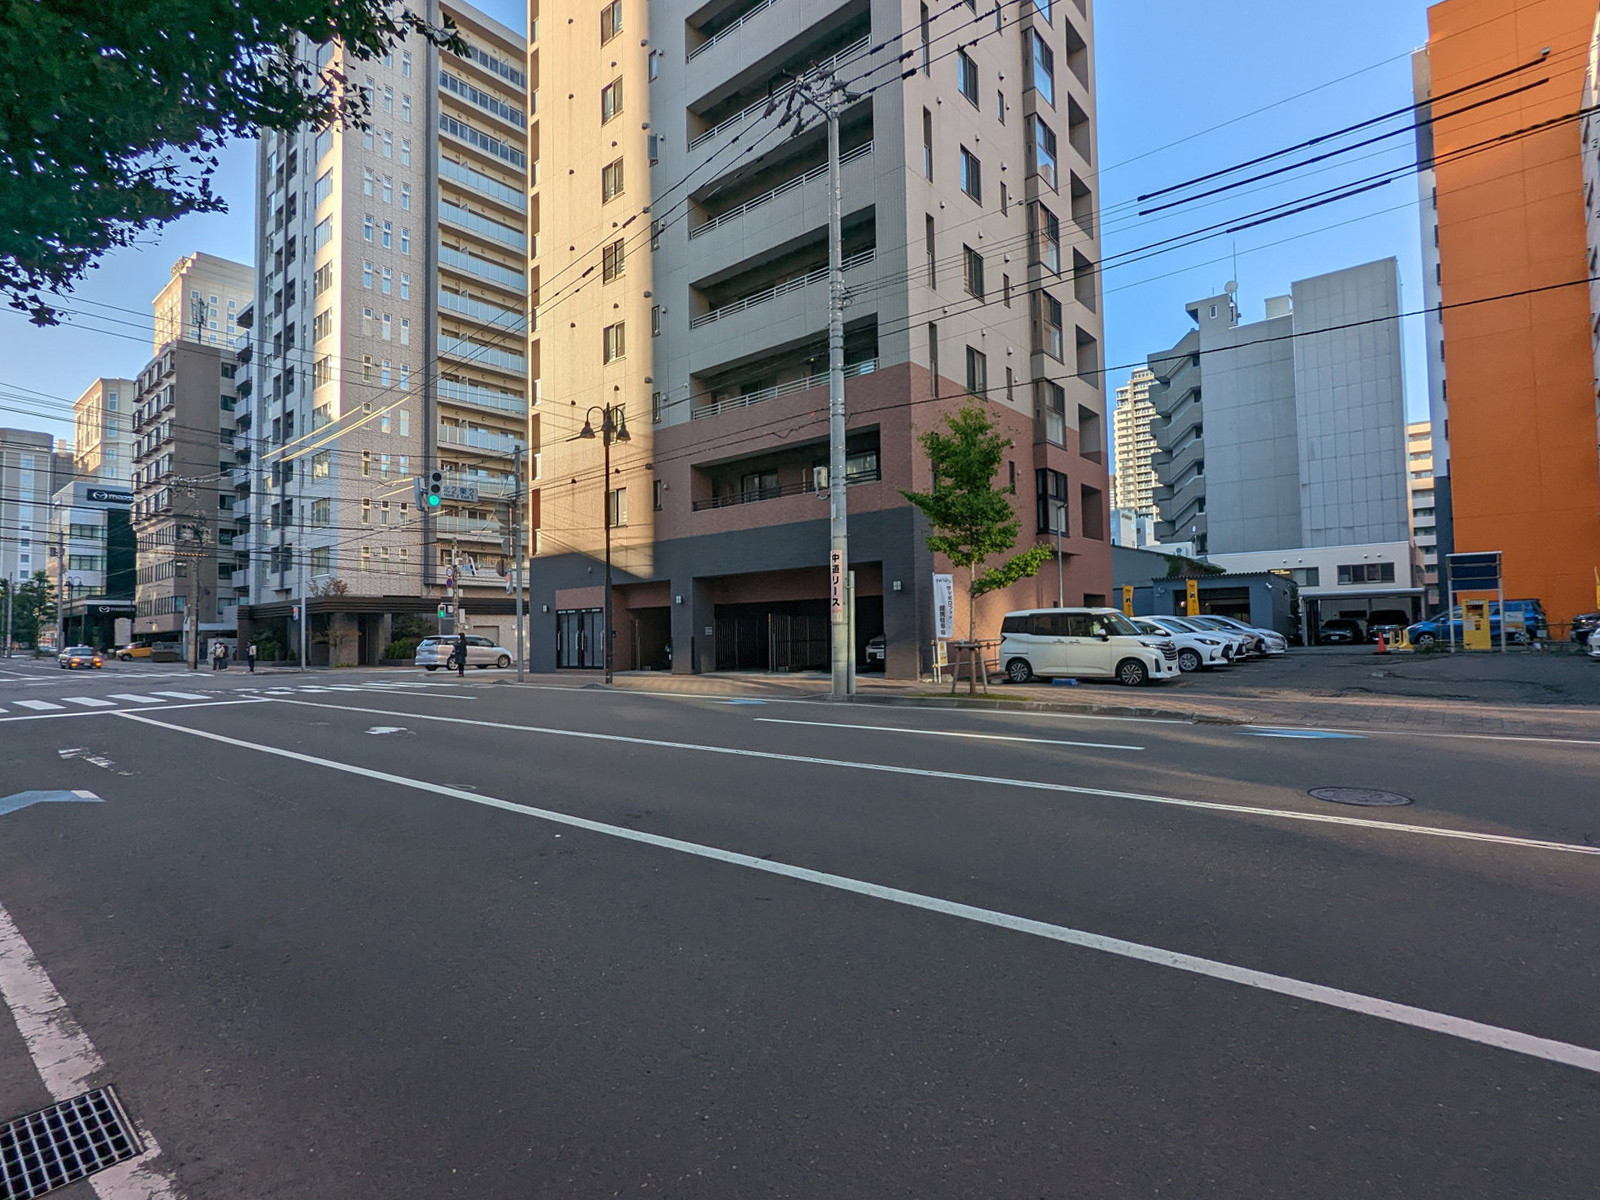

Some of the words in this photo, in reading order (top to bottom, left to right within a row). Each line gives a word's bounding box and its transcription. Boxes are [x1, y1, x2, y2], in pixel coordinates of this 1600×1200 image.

[832, 553, 840, 607] 中道リース
